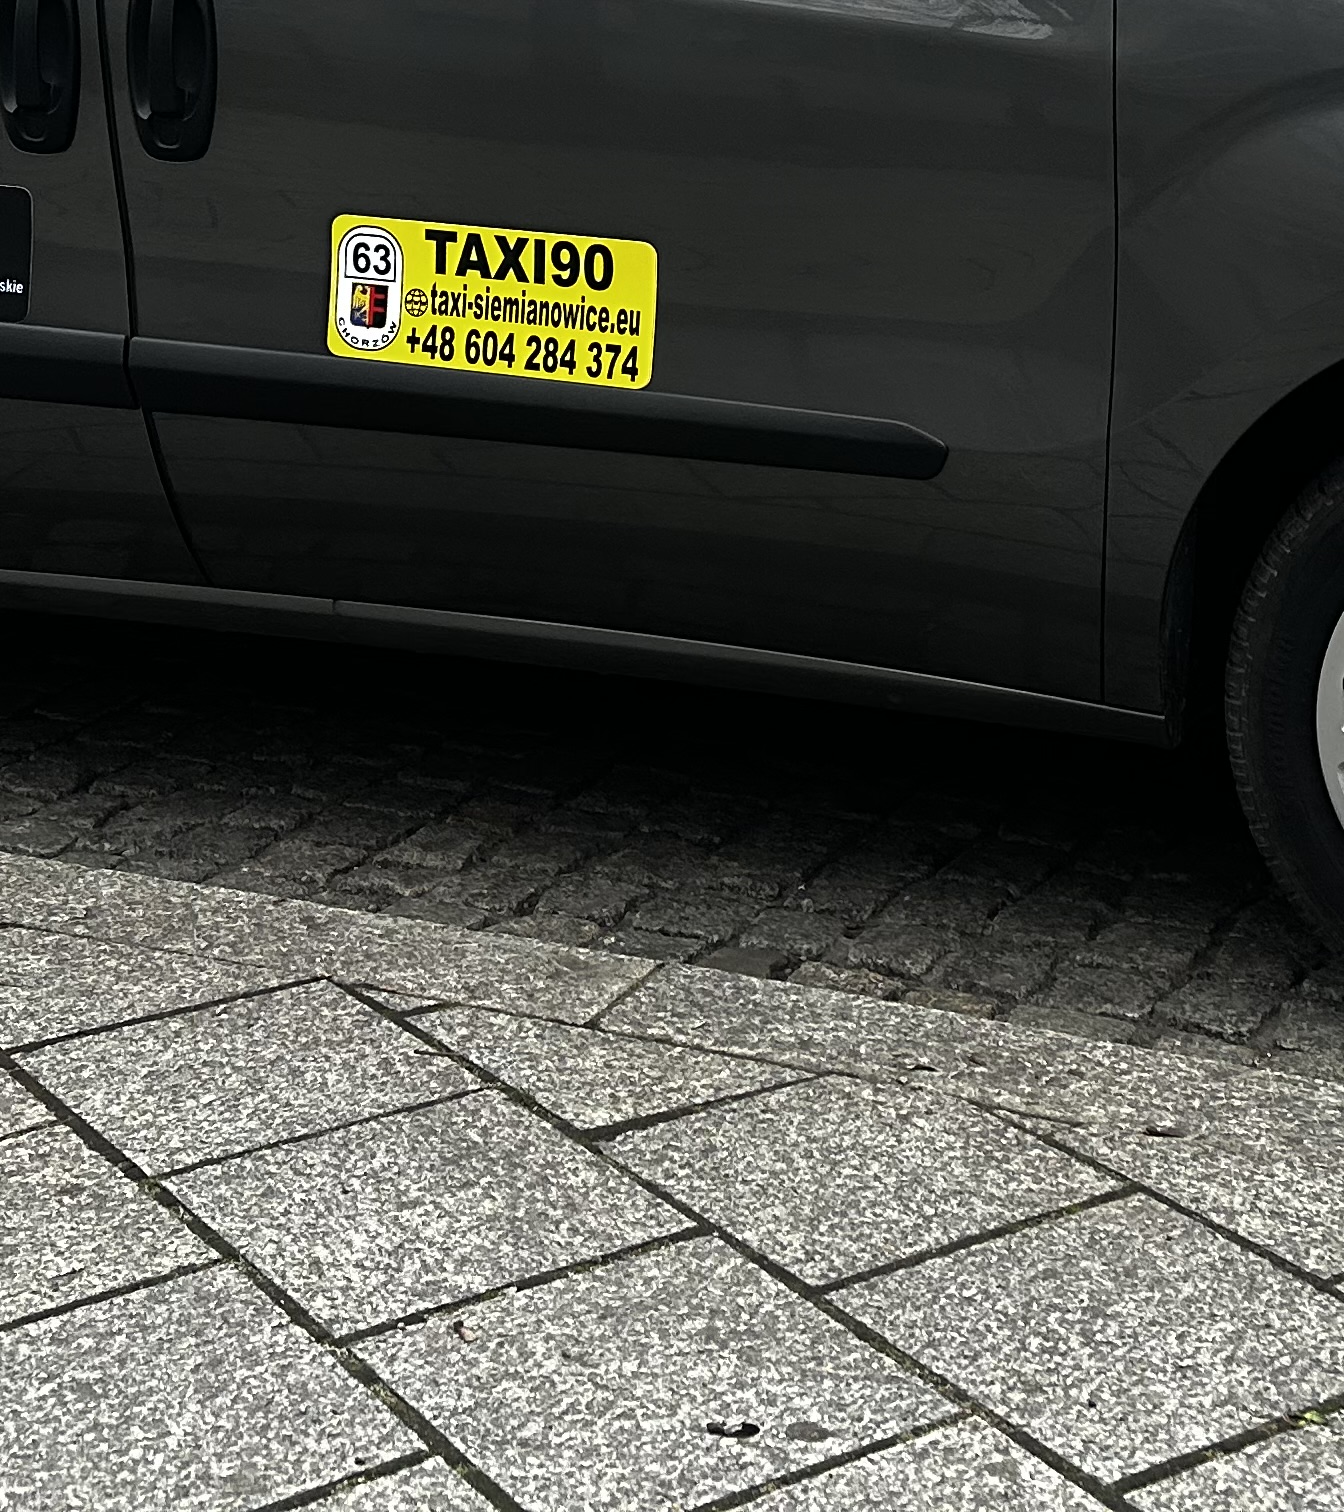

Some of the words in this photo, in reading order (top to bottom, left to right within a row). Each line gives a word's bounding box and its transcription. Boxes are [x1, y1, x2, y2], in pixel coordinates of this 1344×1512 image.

[352, 241, 393, 276] 63
[425, 227, 615, 291] TAXI90
[338, 316, 398, 348] CHORZÓW
[430, 281, 642, 336] taxi-siemianowice.eu
[406, 324, 456, 362] +48
[464, 327, 516, 369] 604
[524, 334, 578, 376] 284
[585, 341, 640, 383] 374
